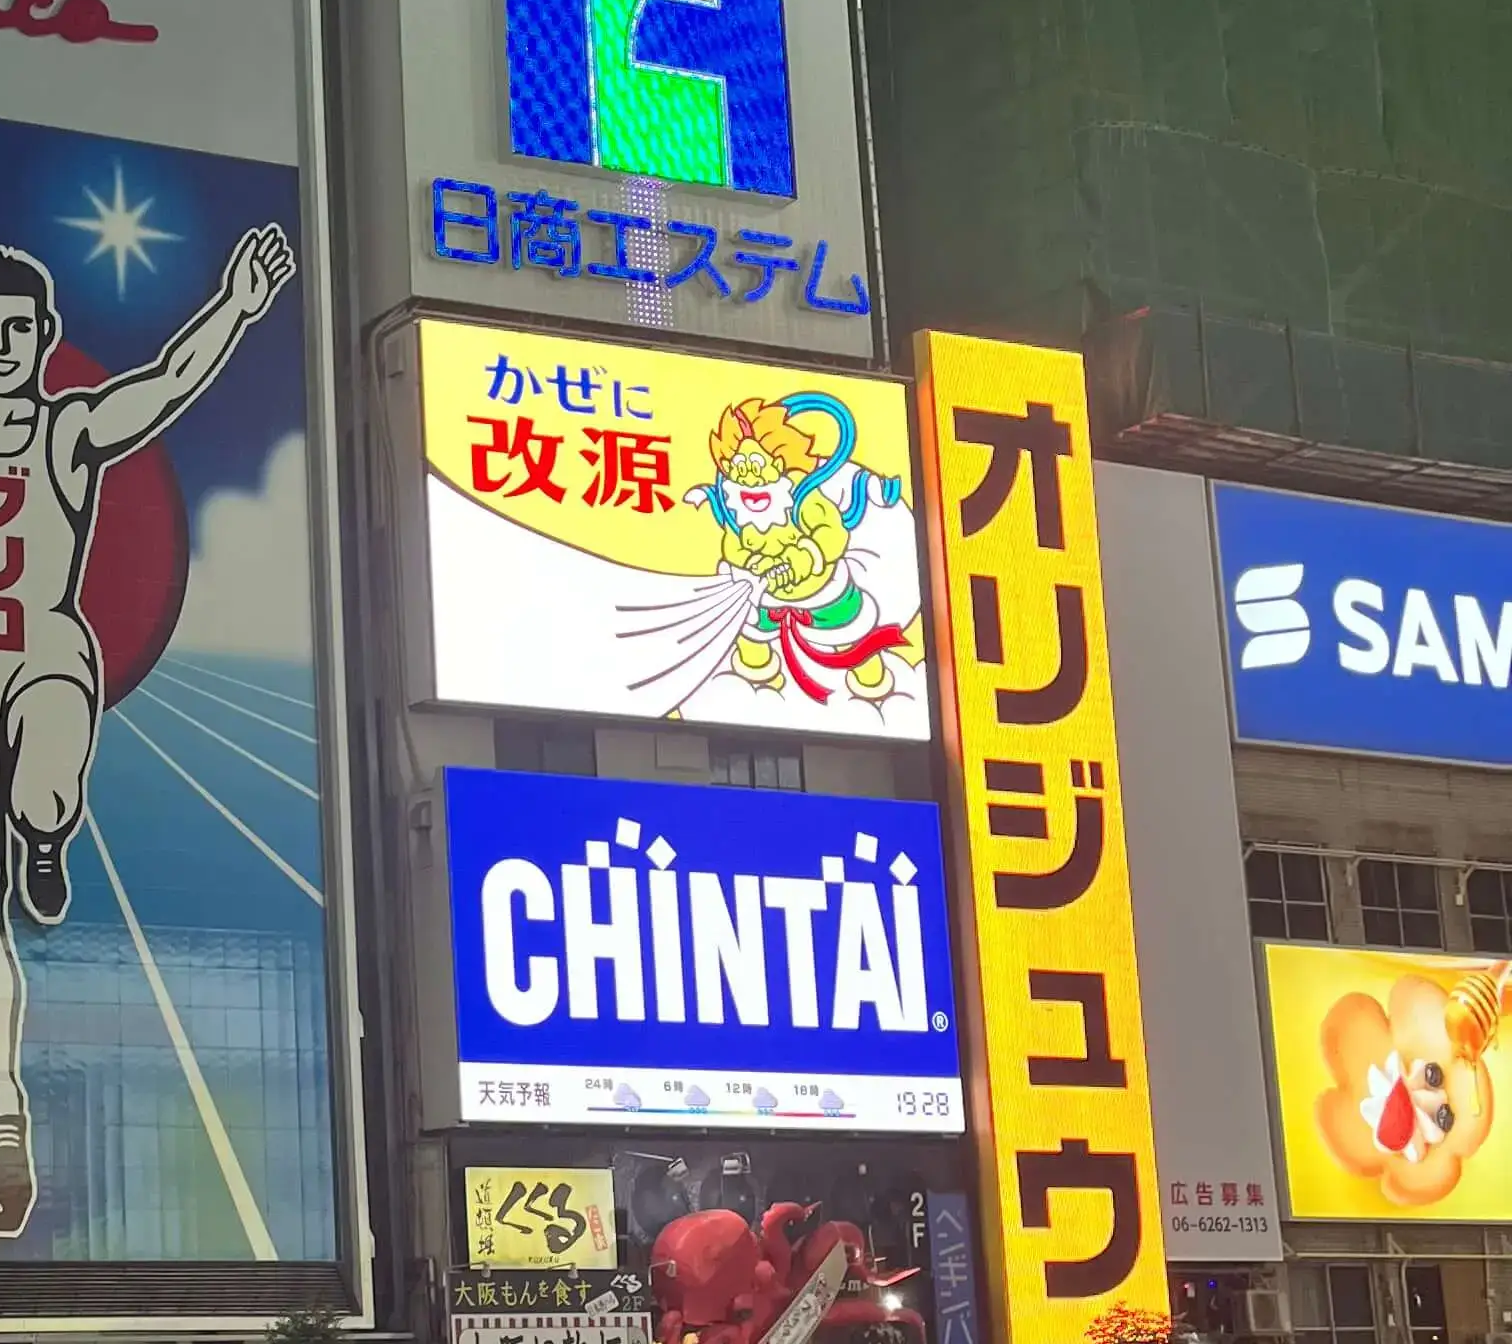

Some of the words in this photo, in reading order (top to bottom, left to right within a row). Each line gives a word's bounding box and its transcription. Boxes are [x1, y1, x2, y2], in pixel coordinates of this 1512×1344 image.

[432, 177, 870, 315] 日商エステム
[484, 354, 653, 423] かぜに
[466, 415, 677, 515] 改源
[952, 400, 1144, 1299] オリジュウ
[478, 1080, 551, 1106] 天気予報
[495, 1181, 587, 1254] くくる
[910, 1192, 925, 1248] 2F
[1171, 1180, 1264, 1206] 広告募集
[1172, 1216, 1268, 1232] 06-6262-1313
[454, 1278, 592, 1307] 大阪もんを食す
[623, 1296, 645, 1311] 2F
